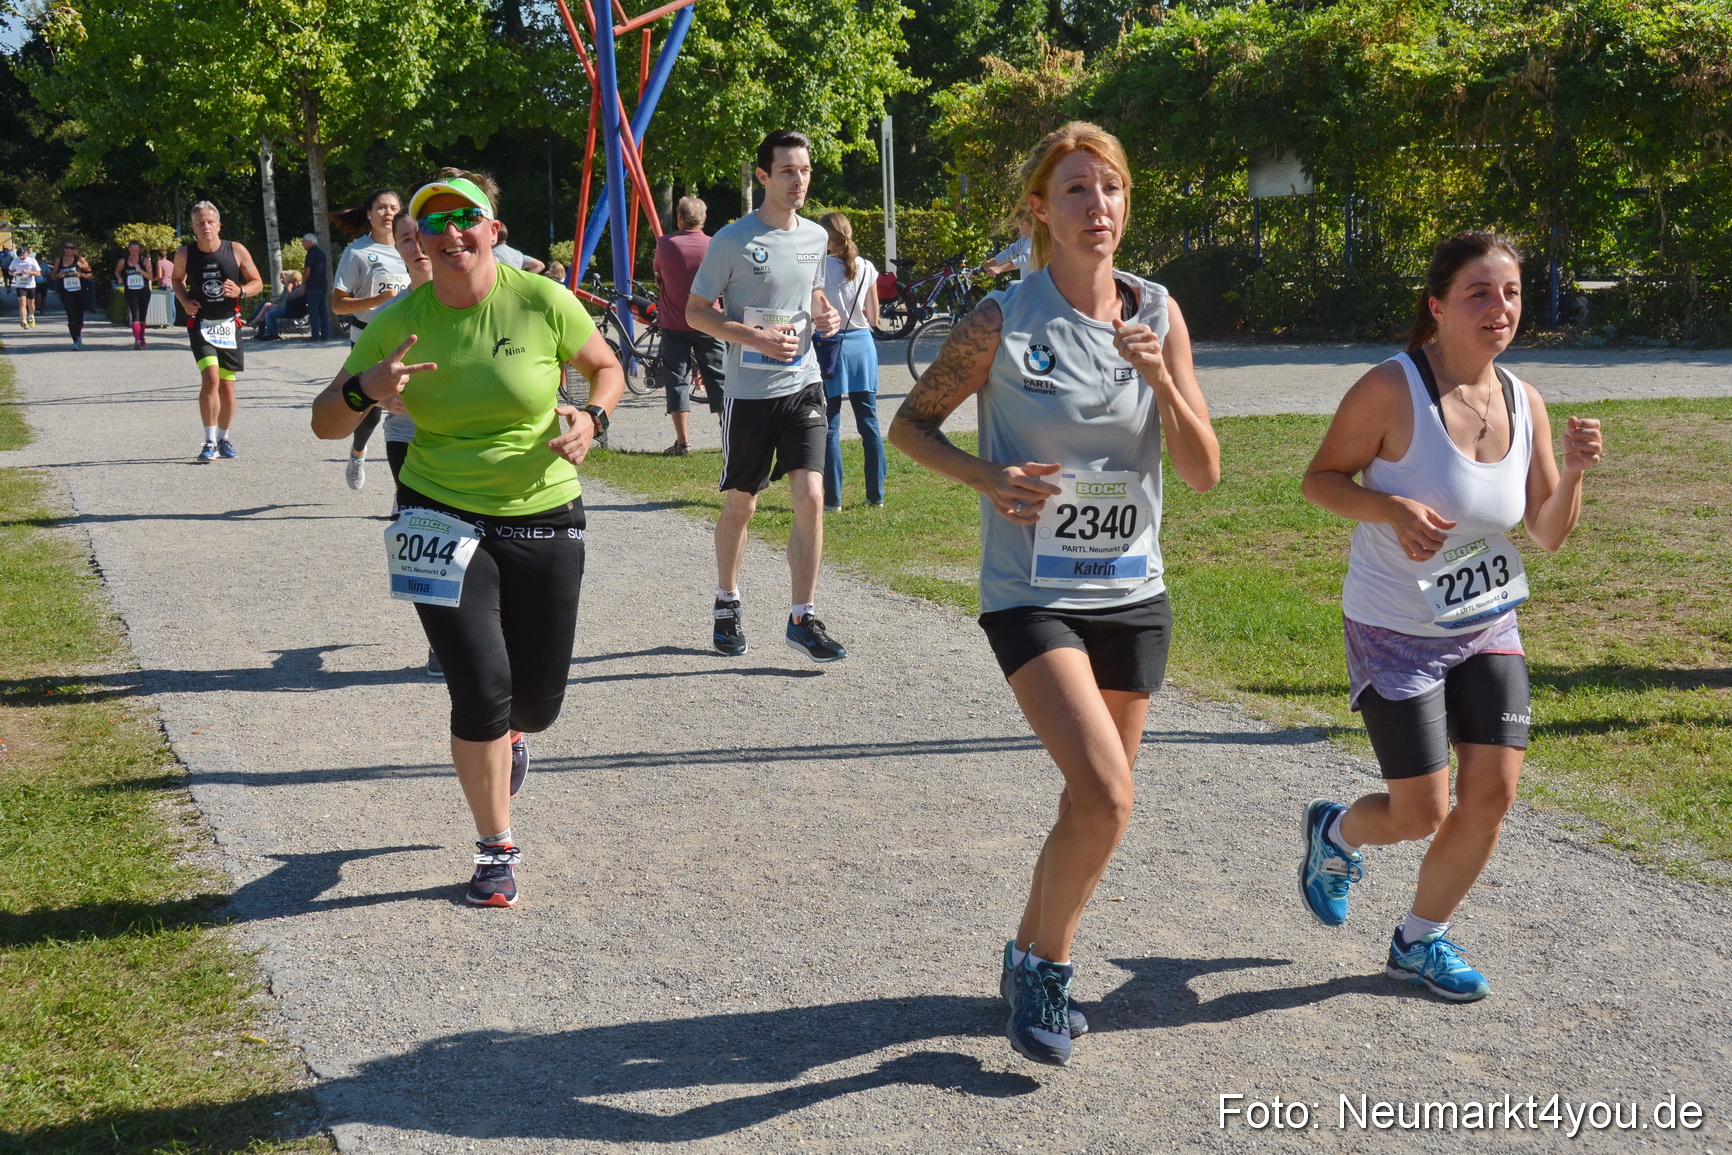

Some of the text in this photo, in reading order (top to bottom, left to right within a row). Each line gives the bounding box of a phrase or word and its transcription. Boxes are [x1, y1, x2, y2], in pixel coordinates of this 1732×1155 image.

[206, 325, 231, 336] 2098
[505, 346, 526, 356] Nina
[1023, 378, 1056, 389] PARTL
[1023, 384, 1056, 396] Neumarkt
[1076, 482, 1127, 495] BOCK
[410, 516, 452, 531] BOCK
[1055, 503, 1137, 540] 2340
[396, 532, 459, 565] 2044
[1062, 545, 1121, 553] PARTL Neumarkt
[1443, 538, 1489, 563] BOCK
[413, 567, 439, 575] Neumarkt
[1074, 561, 1116, 576] Katrin
[408, 579, 430, 593] Nina
[1437, 555, 1510, 607] 2213
[1501, 712, 1530, 725] JAKO
